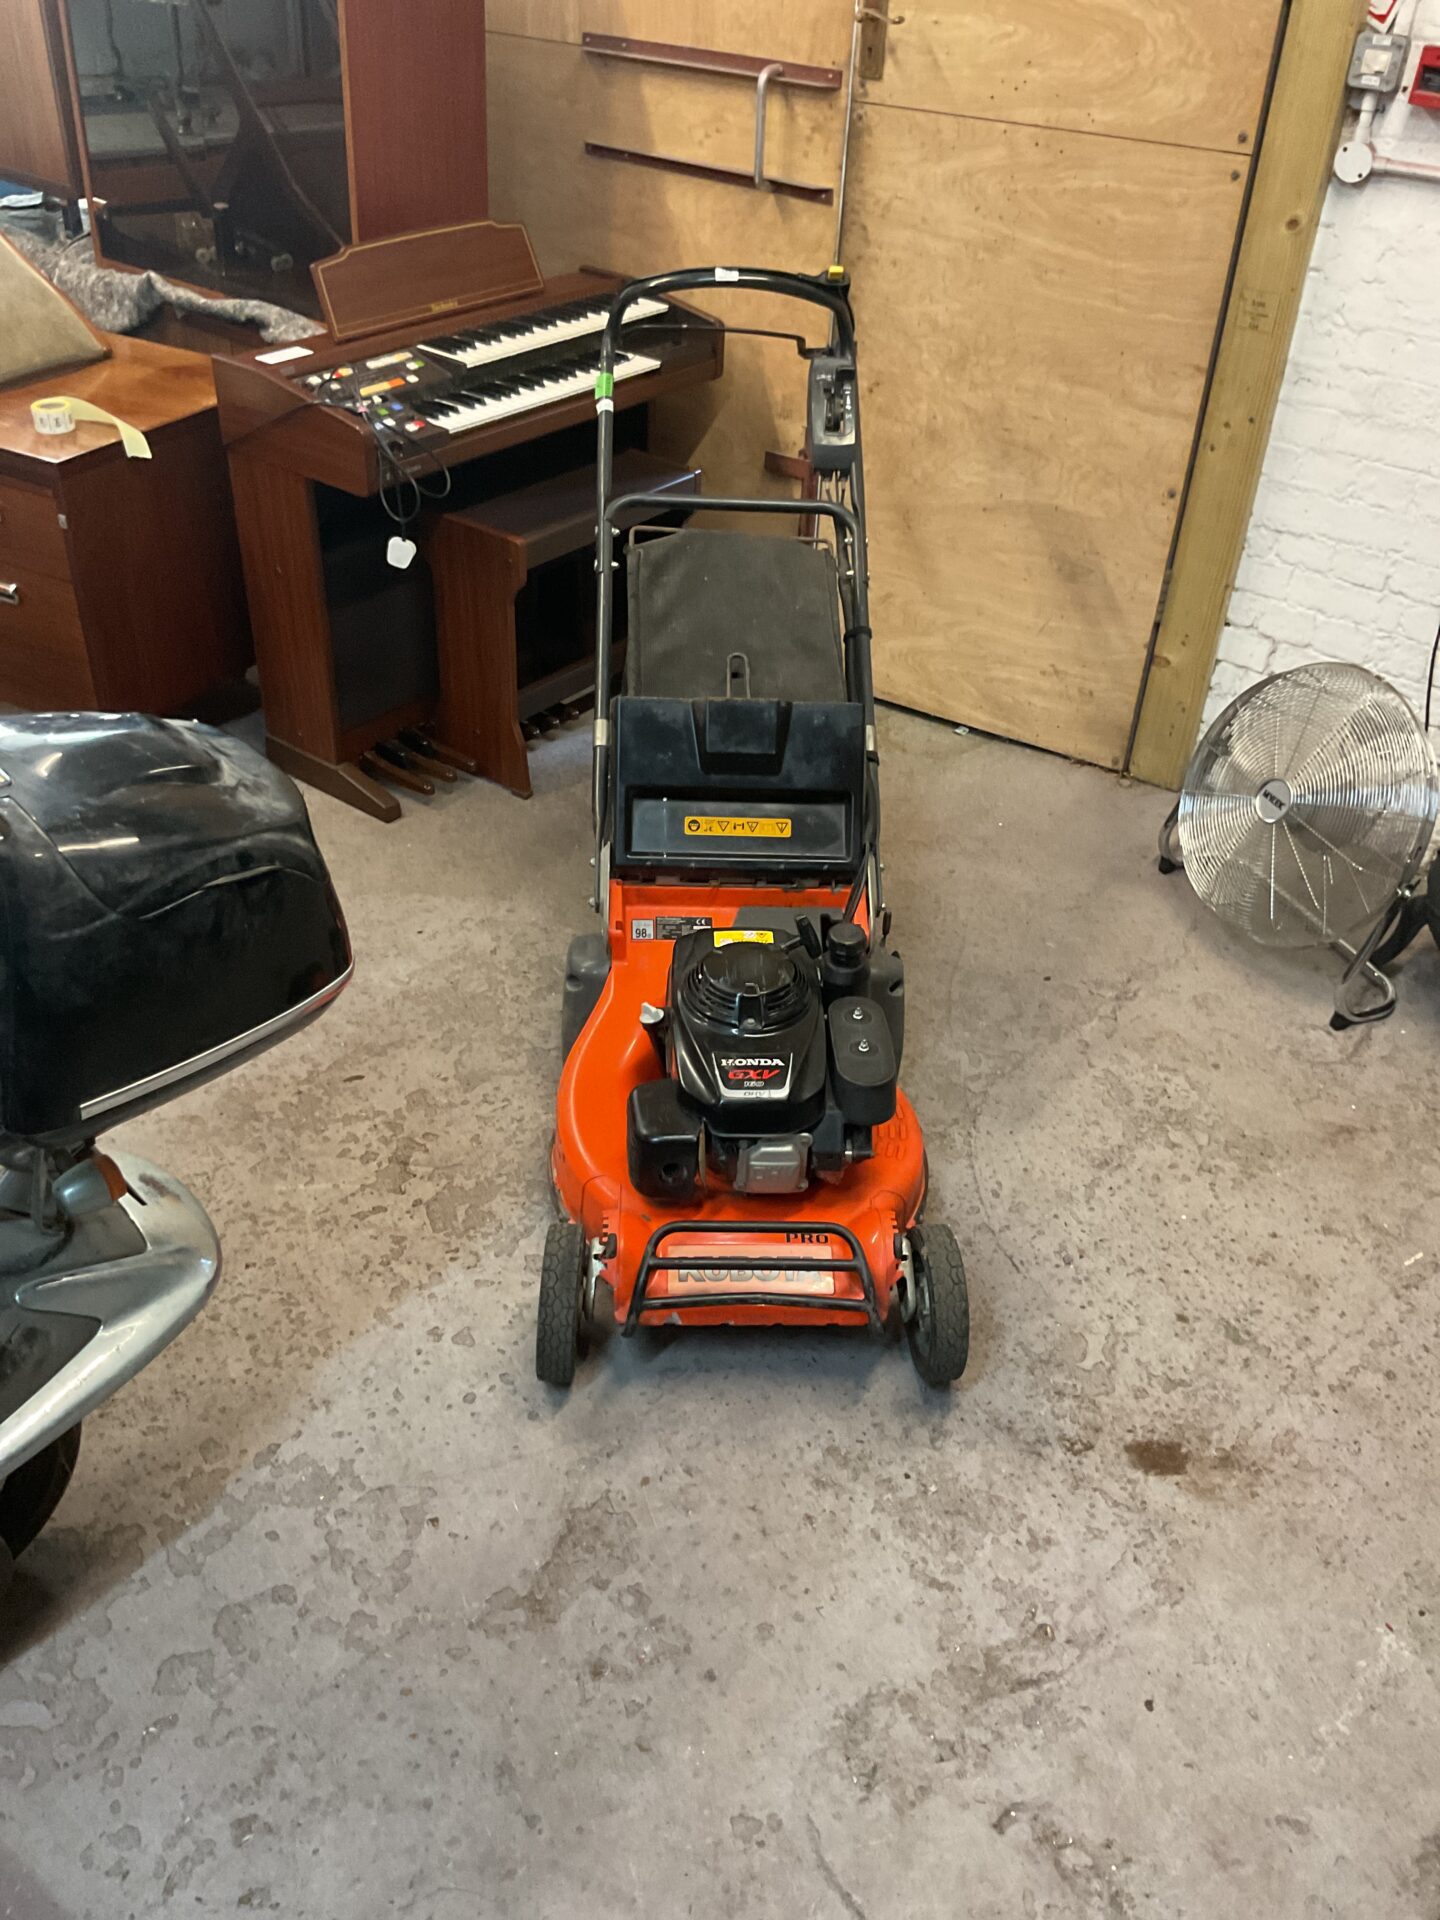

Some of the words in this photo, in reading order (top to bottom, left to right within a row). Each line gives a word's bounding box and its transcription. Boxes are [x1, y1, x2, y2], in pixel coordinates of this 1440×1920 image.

[635, 928, 647, 938] 98
[720, 1058, 785, 1066] HONDA
[728, 1069, 781, 1079] GXV
[785, 1232, 829, 1244] PRO
